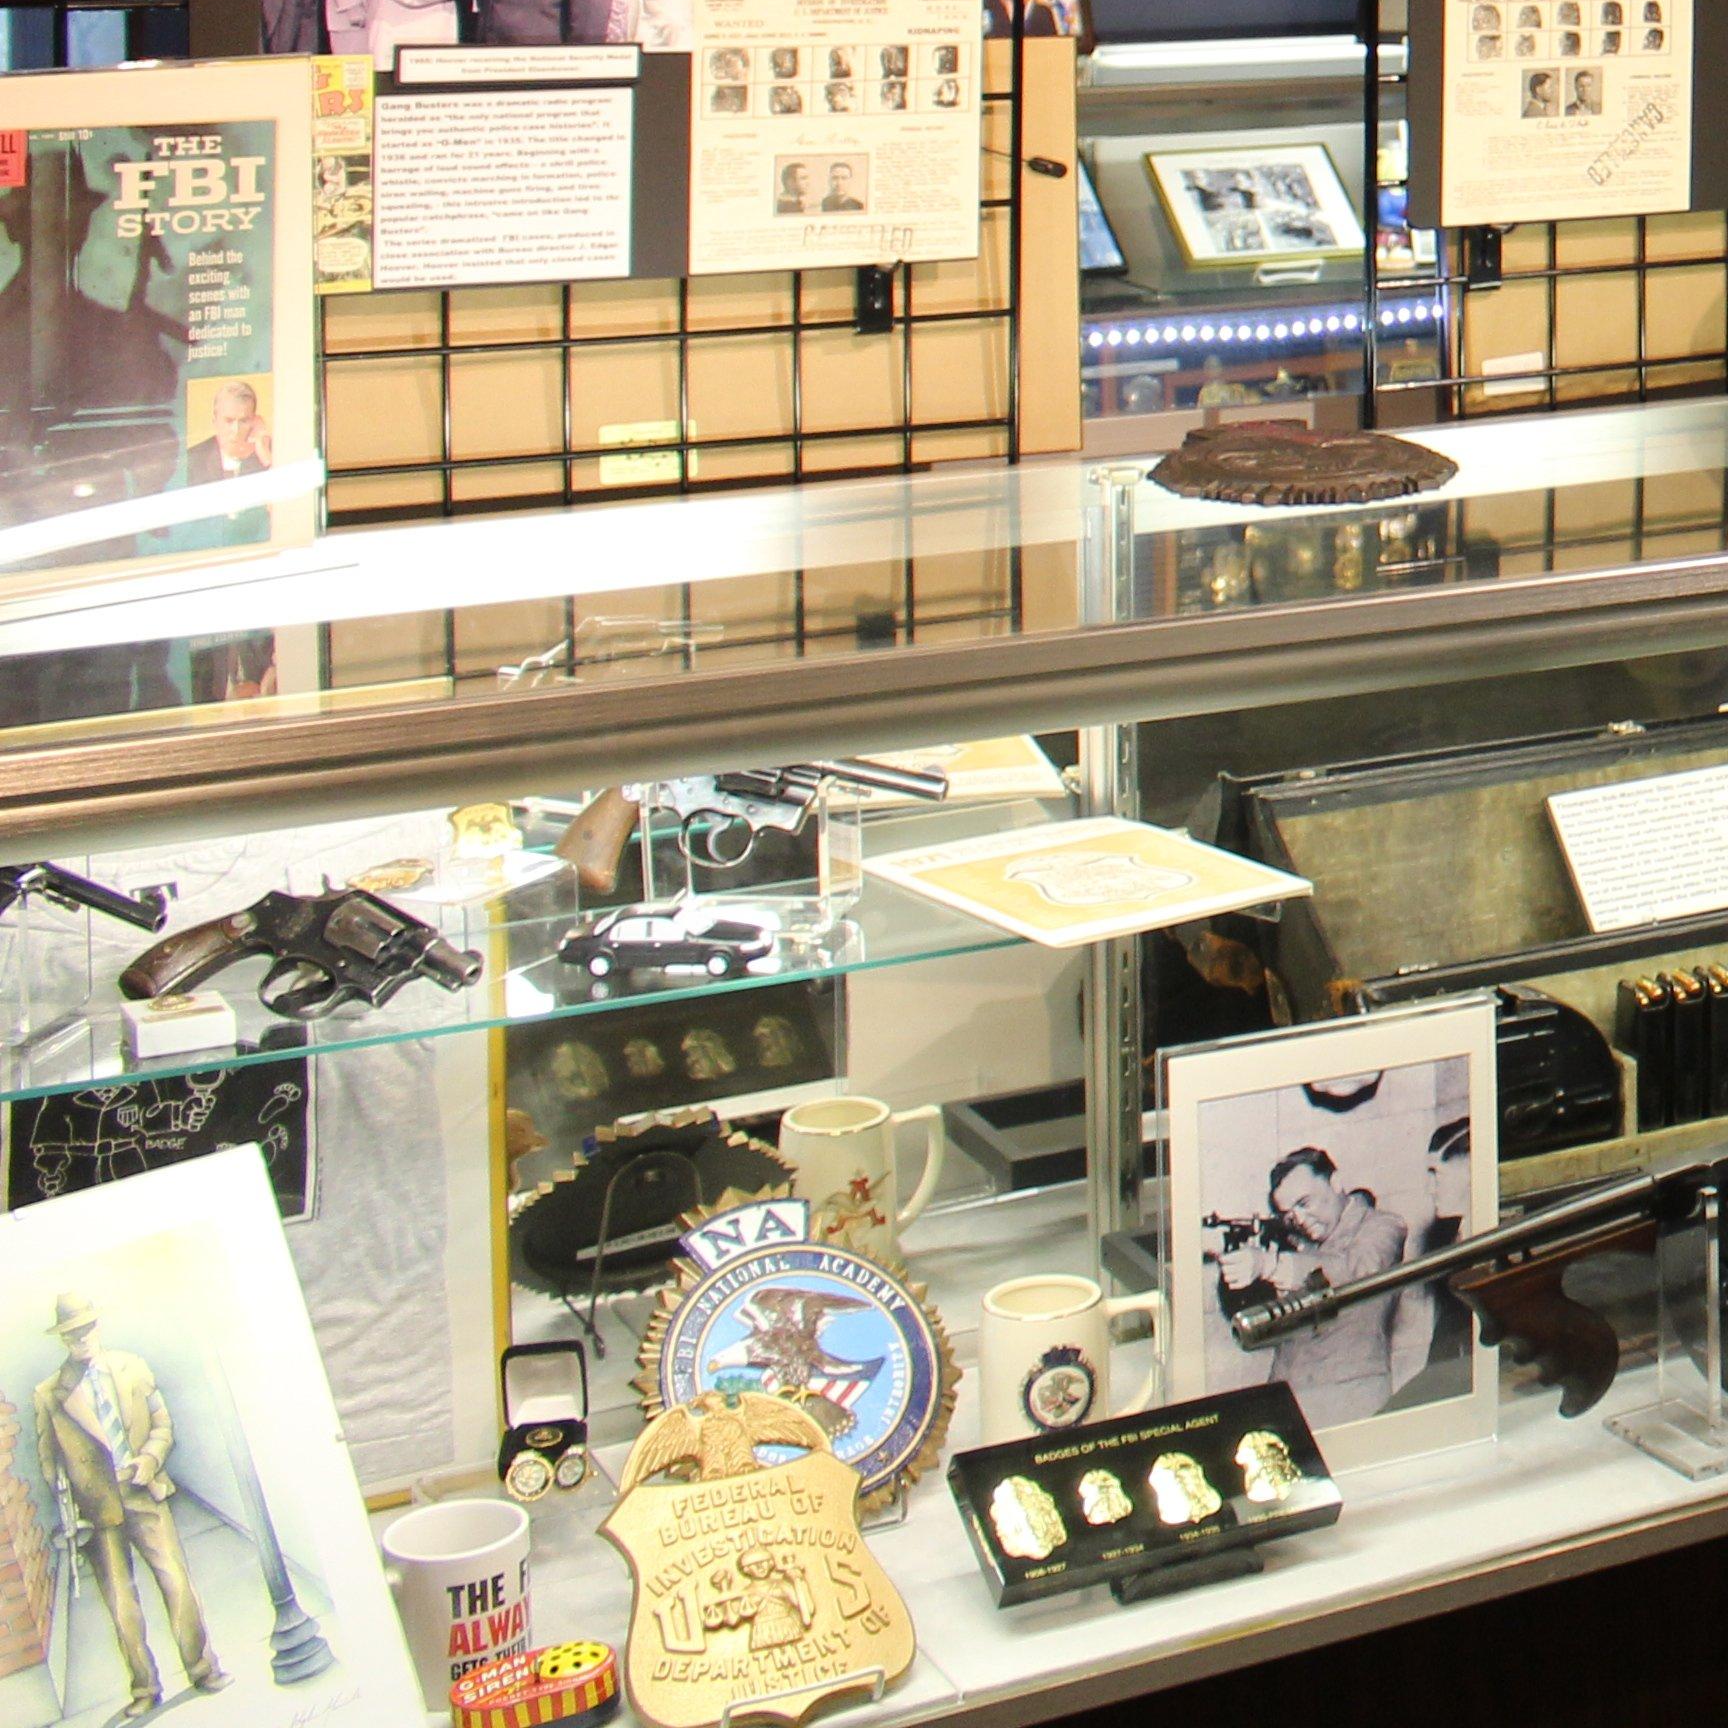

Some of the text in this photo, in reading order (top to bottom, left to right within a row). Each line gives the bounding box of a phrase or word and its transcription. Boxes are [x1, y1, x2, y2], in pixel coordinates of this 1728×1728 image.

[154, 135, 222, 156] THE
[113, 156, 266, 210] FBI
[117, 207, 261, 238] STORY
[188, 250, 243, 267] Behind the
[188, 270, 230, 287] exciting
[189, 287, 251, 303] scenes with
[189, 306, 246, 320] an FBI man
[187, 343, 228, 362] justice!
[188, 325, 252, 341] dedicated to
[700, 1208, 796, 1258] NA
[697, 1256, 790, 1315] NATIONAL
[819, 1254, 905, 1311] ACADEMY
[1033, 1413, 1219, 1465] BADGES OF THE FBI SPECIAL AGENT
[672, 1475, 806, 1519] FEDERAL
[658, 1495, 824, 1547] BUREAU OF
[645, 1526, 857, 1599] INVESTIGATION
[447, 1574, 505, 1619] THE
[653, 1553, 872, 1655] U S
[651, 1605, 892, 1682] DEPARTMENT OF
[463, 1665, 530, 1704] SIREN
